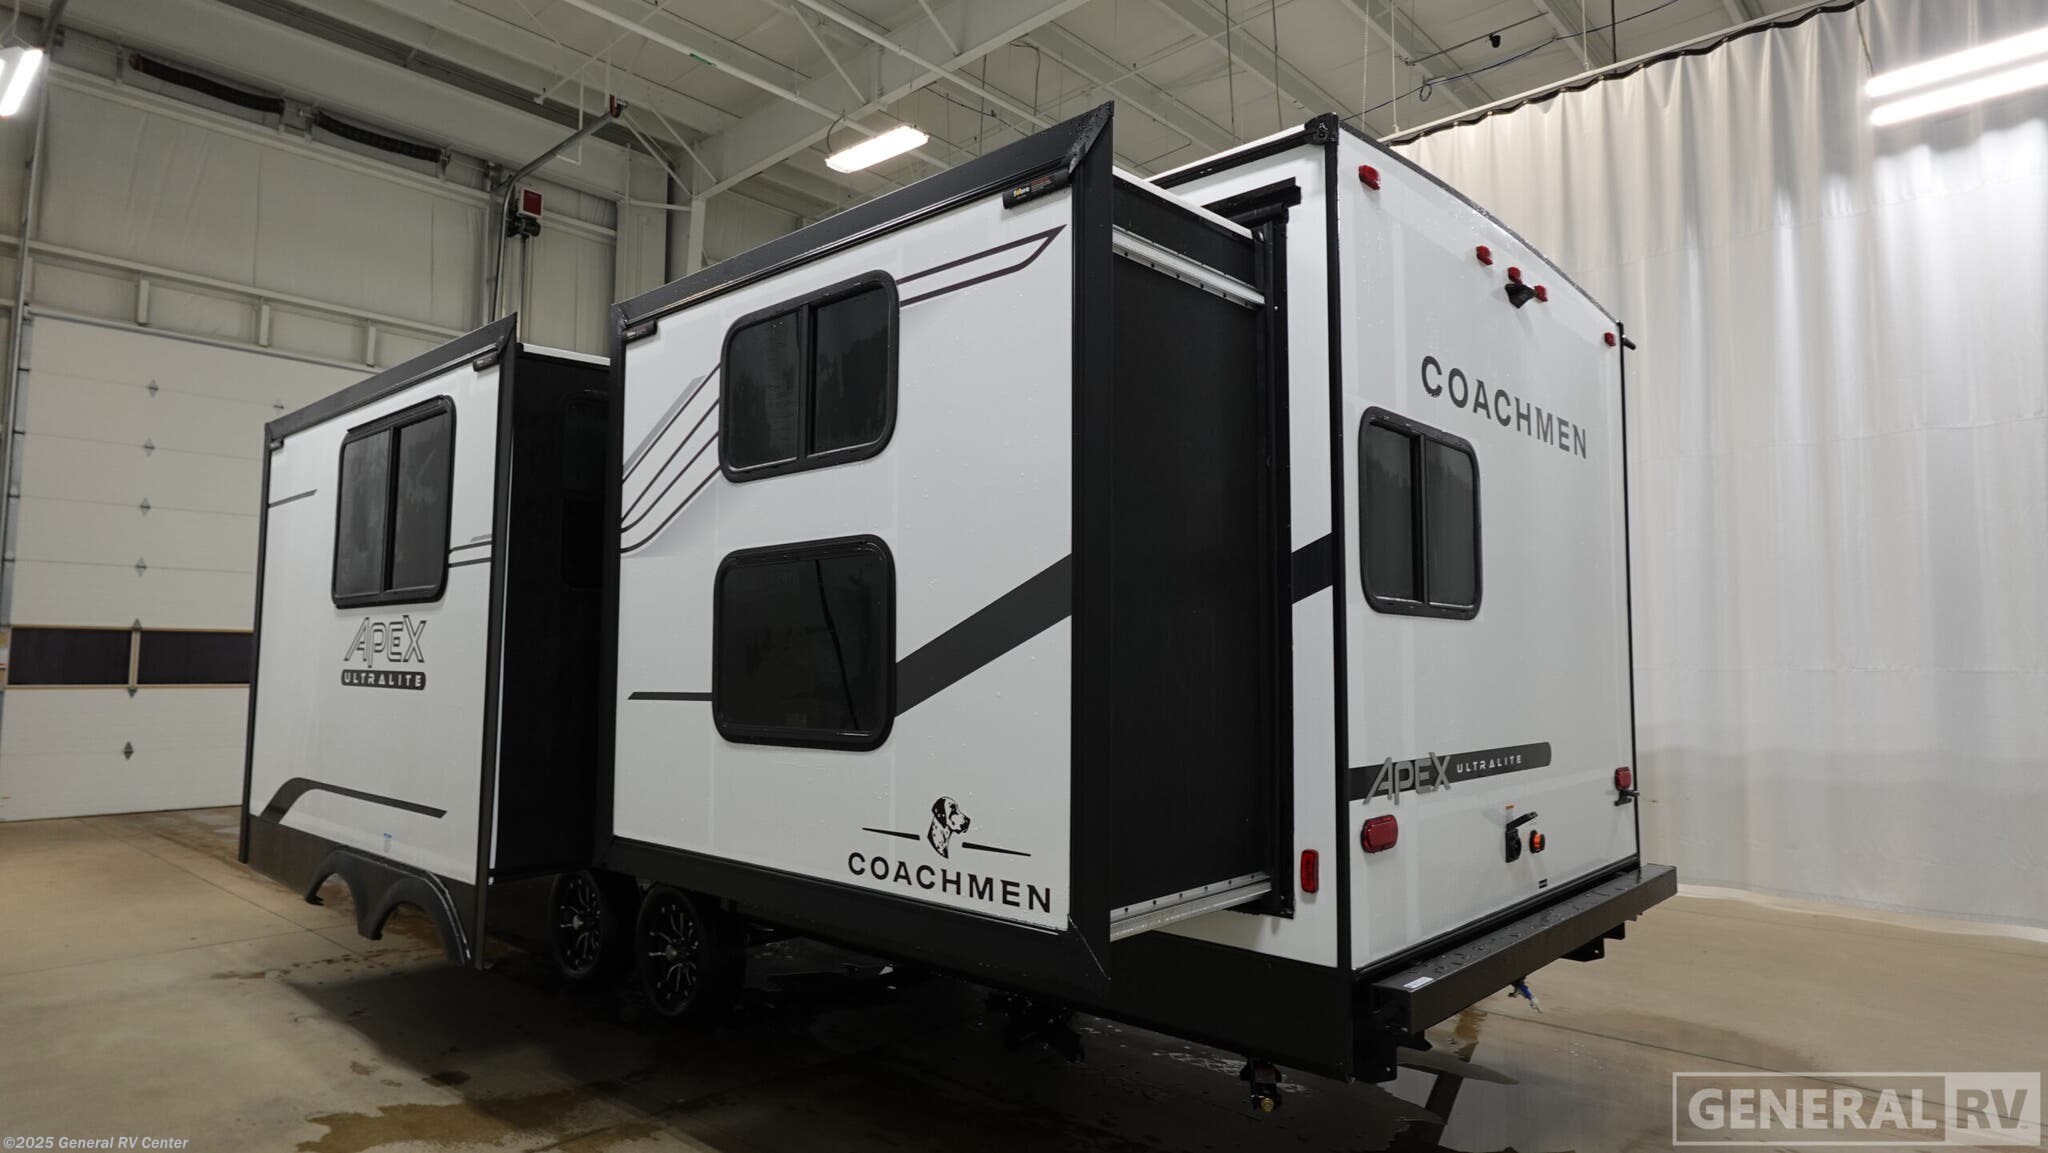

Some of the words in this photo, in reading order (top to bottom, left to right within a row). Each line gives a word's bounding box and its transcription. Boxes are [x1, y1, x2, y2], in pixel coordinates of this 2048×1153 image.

[1421, 355, 1587, 460] COACHMEN
[343, 614, 427, 669] APEX
[343, 671, 422, 687] ULTRALITE
[1362, 751, 1451, 806] APEX
[1456, 754, 1522, 774] ULTRALITE
[848, 852, 1050, 914] COACHMEN
